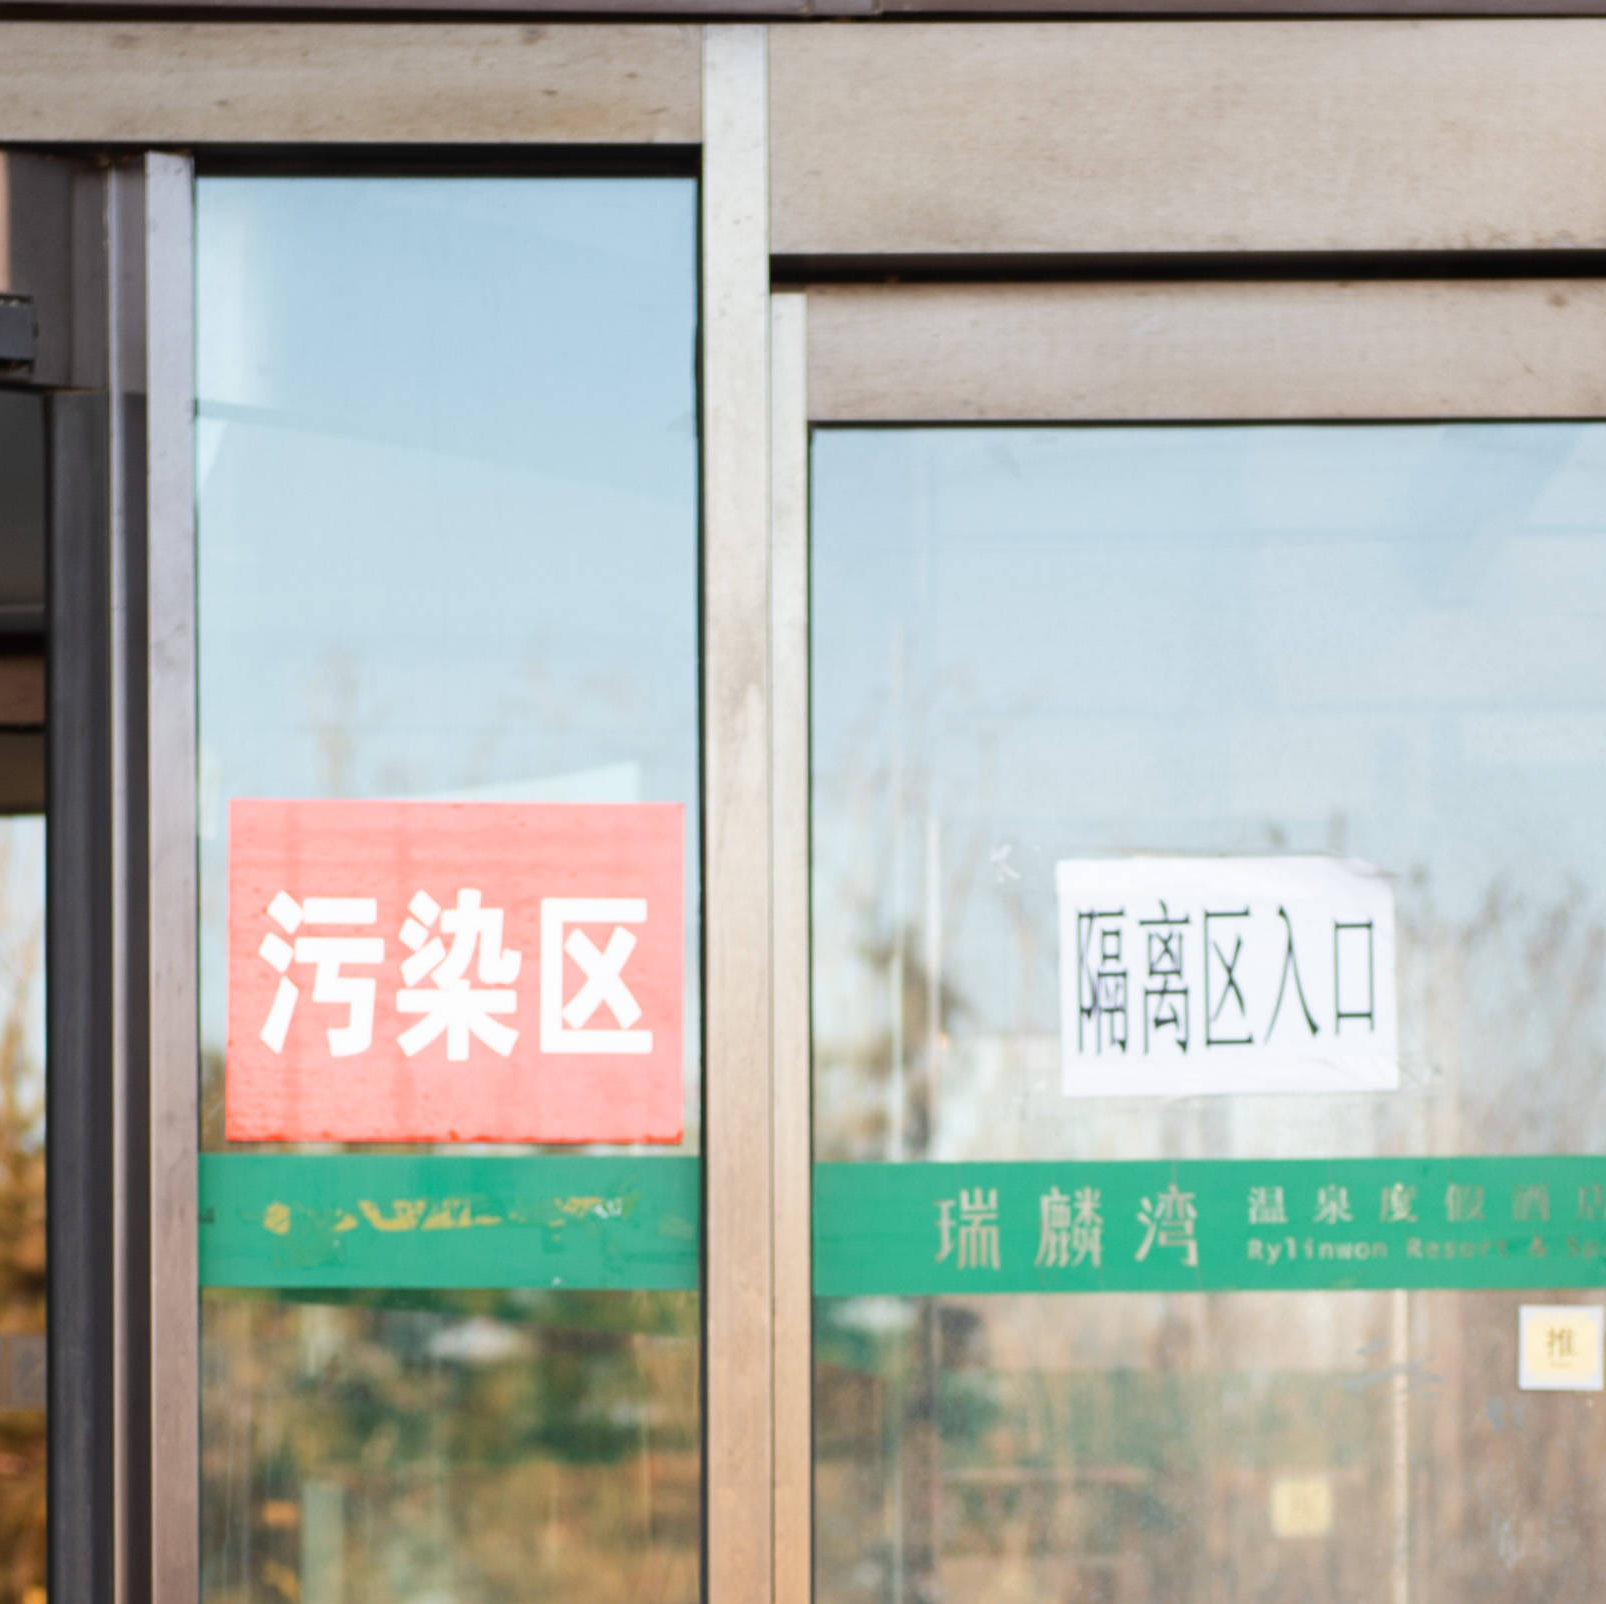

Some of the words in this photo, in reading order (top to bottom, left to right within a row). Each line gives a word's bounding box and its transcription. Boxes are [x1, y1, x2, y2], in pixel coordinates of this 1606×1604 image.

[258, 889, 654, 1062] 污染区
[1077, 899, 1375, 1055] 隔离区入口
[933, 1183, 1199, 1269] 瑞麟湾
